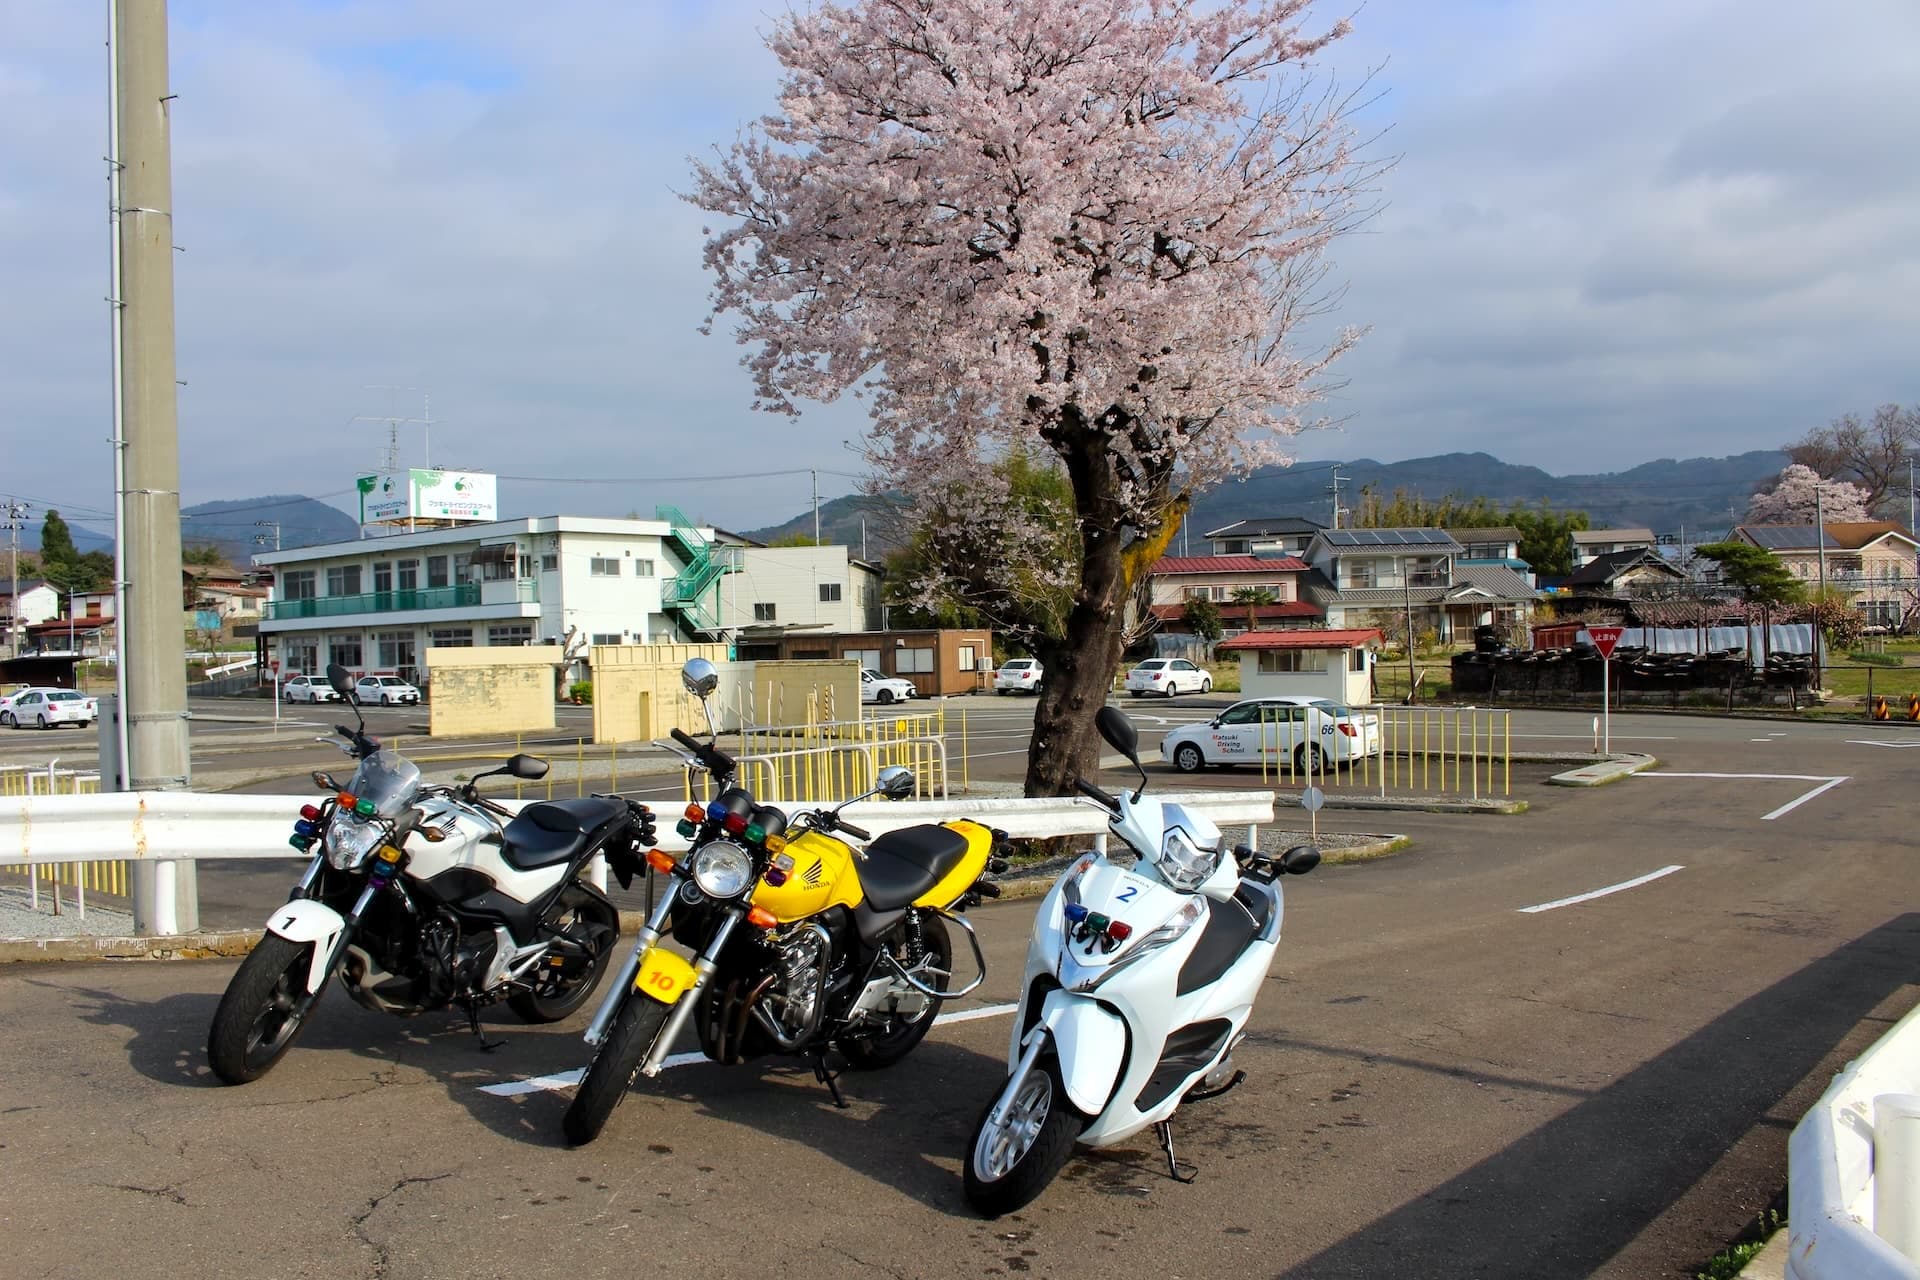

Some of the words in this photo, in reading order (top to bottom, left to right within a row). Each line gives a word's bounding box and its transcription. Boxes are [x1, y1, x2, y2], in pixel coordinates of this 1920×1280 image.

[1595, 633, 1617, 641] 止まれ
[1321, 724, 1335, 735] 66
[803, 881, 831, 892] HONDA
[1115, 886, 1138, 903] 2
[282, 916, 297, 930] 1
[649, 971, 675, 991] 10
